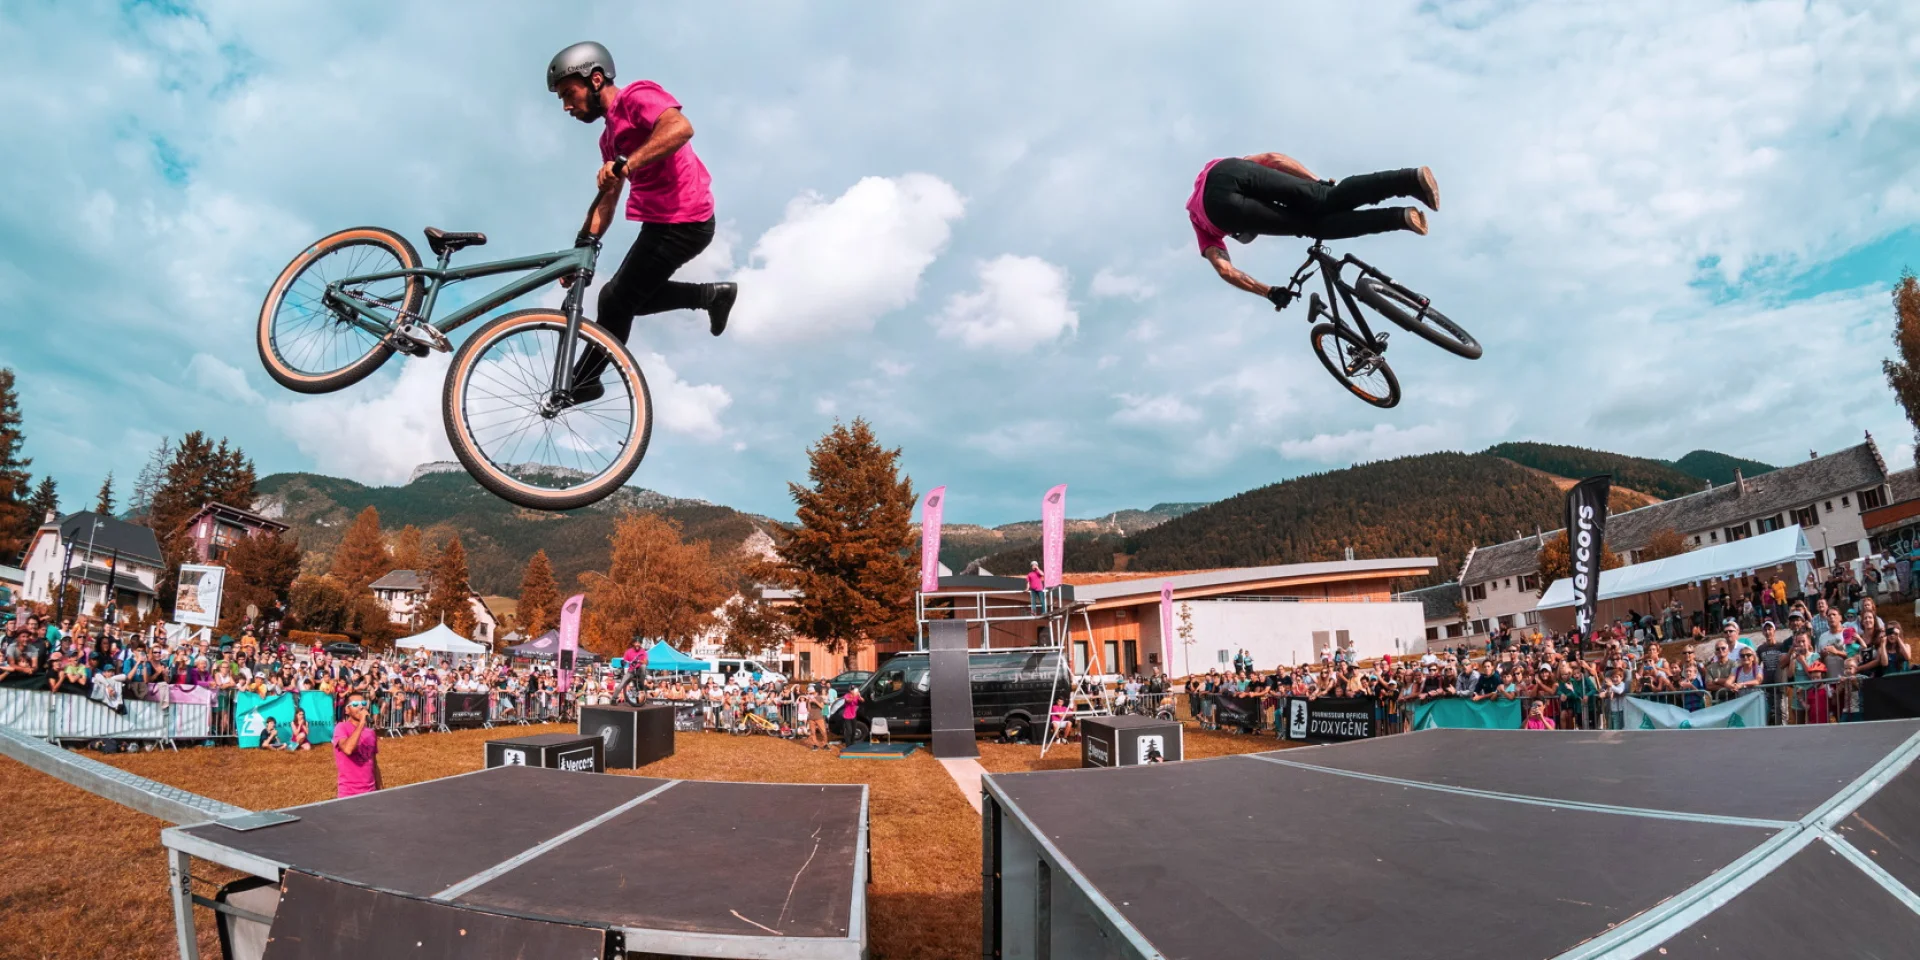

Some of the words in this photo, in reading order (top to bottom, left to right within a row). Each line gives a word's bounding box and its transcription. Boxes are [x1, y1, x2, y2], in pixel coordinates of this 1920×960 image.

[1574, 505, 1594, 606] Vercors
[1311, 711, 1344, 719] FOURNISSEUR
[1345, 712, 1369, 720] OFFICIEL
[1311, 719, 1369, 737] D'OXYGÈNE
